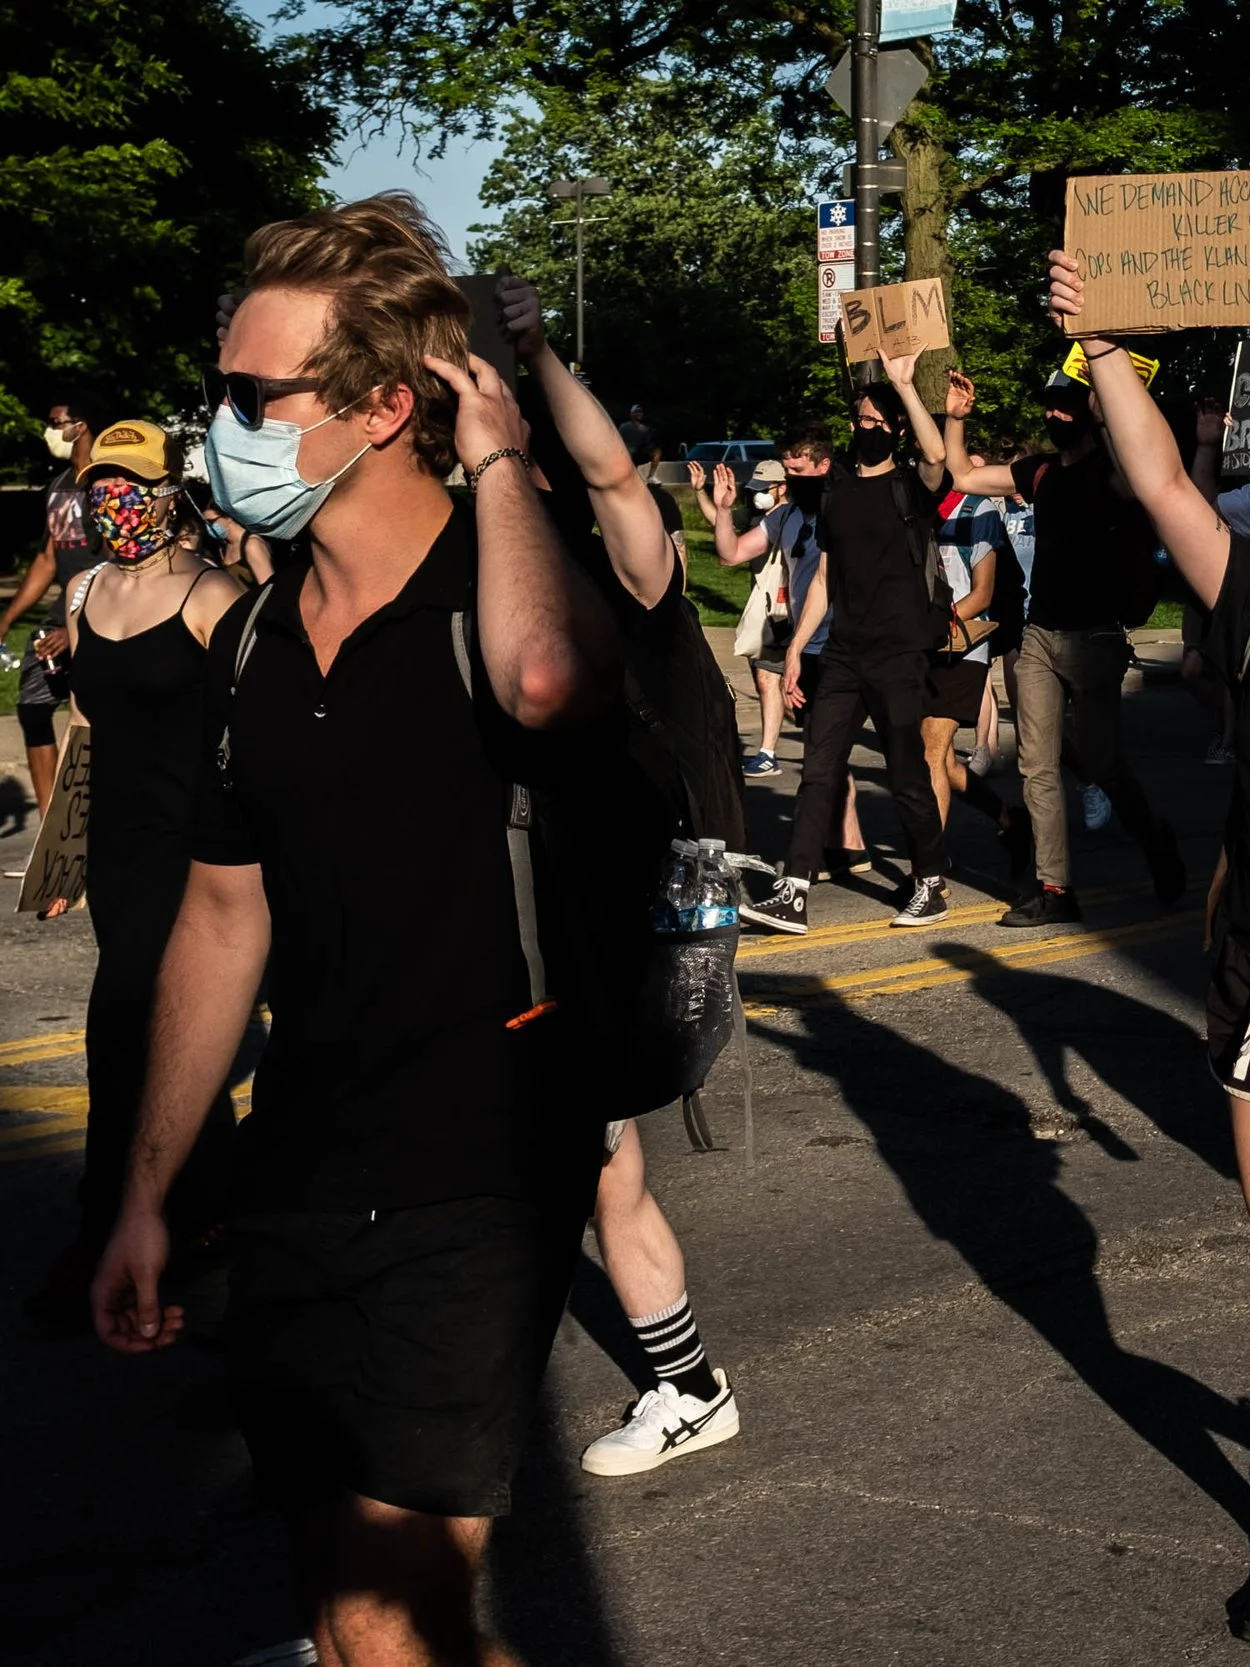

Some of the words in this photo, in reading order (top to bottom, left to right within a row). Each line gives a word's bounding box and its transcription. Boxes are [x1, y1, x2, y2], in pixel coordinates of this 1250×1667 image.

[1074, 183, 1114, 216] WE
[1120, 179, 1214, 210] DEMAND
[1172, 212, 1243, 240] KILLER
[1120, 250, 1159, 276] AND
[1161, 246, 1193, 270] THE
[1204, 245, 1248, 271] KLAN
[1146, 278, 1215, 310] BLACK
[845, 284, 946, 337] BLM
